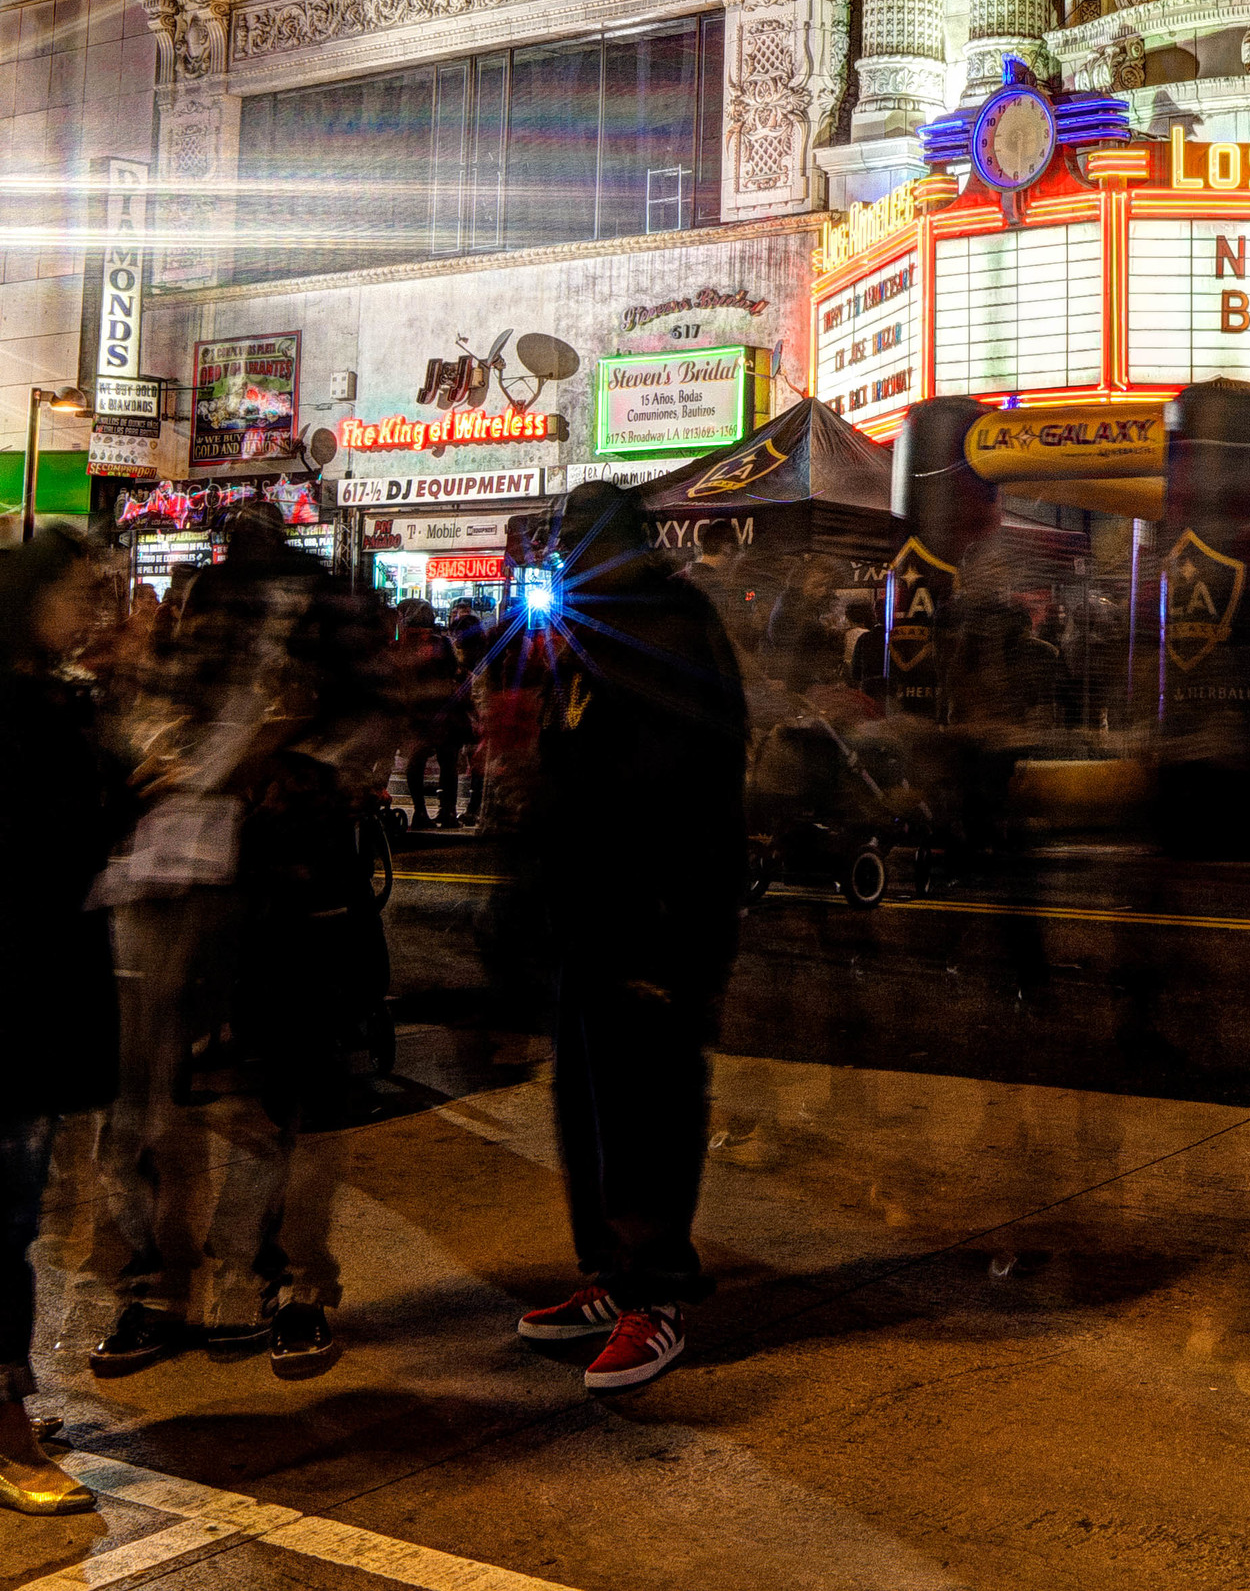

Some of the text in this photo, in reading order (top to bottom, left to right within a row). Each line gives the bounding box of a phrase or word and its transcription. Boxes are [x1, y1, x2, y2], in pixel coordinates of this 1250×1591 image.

[998, 105, 1006, 114] 11
[986, 118, 996, 127] 10
[982, 139, 988, 148] 9
[987, 157, 993, 166] 8
[998, 169, 1003, 178] 7
[1013, 171, 1018, 180] 6
[822, 303, 844, 335] HAPPY
[671, 324, 701, 339] 617
[229, 358, 293, 381] DIMANTES
[608, 358, 740, 391] Steven's Bridal
[135, 385, 158, 397] GOLD
[640, 390, 703, 406] 15 Años, Bodas
[108, 398, 153, 413] DIAMONDS
[627, 405, 716, 423] Comuniones, Bautizos
[342, 409, 547, 450] The King of Wireless
[976, 419, 1156, 450] LA GALAXY
[205, 434, 221, 443] WE
[223, 433, 244, 443] BUY
[606, 432, 620, 444] 617
[628, 430, 667, 445] Broadway
[195, 442, 220, 458] GOLD
[220, 441, 240, 456] AND
[710, 463, 755, 481] LA
[386, 478, 413, 500] DJ
[416, 474, 534, 499] EQUIPMENT
[426, 523, 462, 540] Mobile
